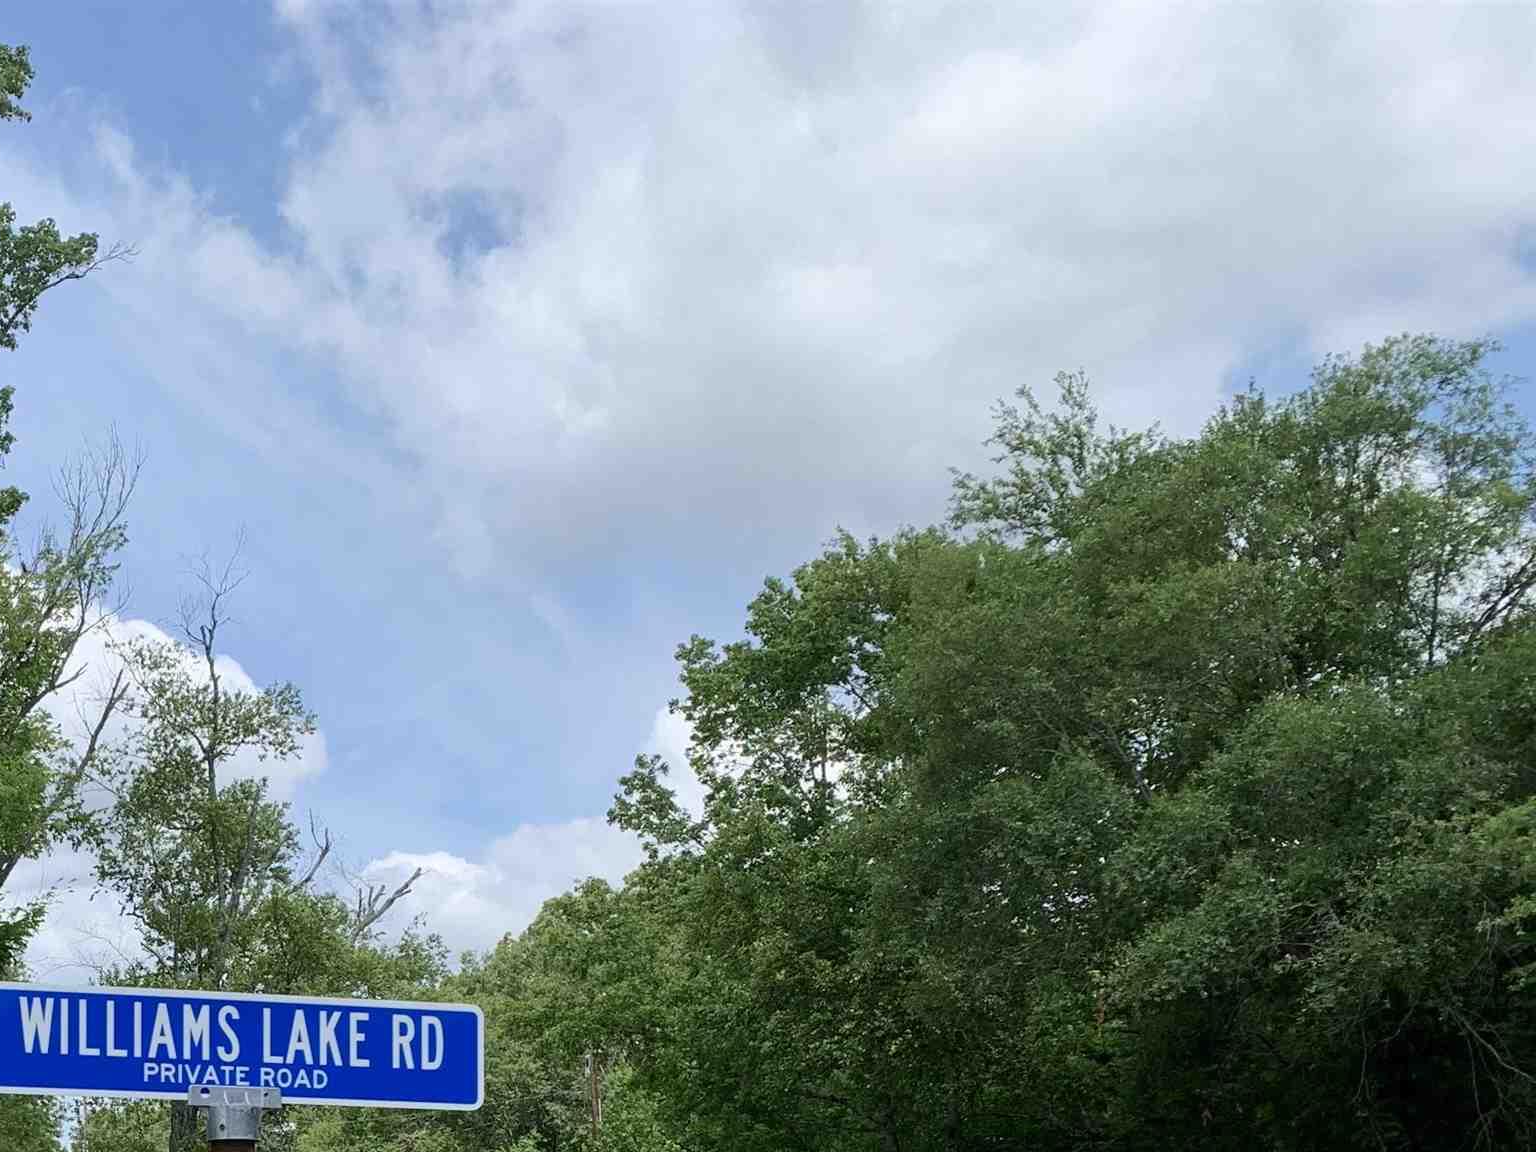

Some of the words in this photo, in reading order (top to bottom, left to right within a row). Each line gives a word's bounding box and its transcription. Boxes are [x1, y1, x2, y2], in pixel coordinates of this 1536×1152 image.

[18, 996, 240, 1062] WILLIAMS
[263, 1008, 371, 1067] LAKE
[391, 1015, 445, 1070] RD
[143, 1062, 250, 1086] PRIVATE
[260, 1067, 329, 1089] ROAD
